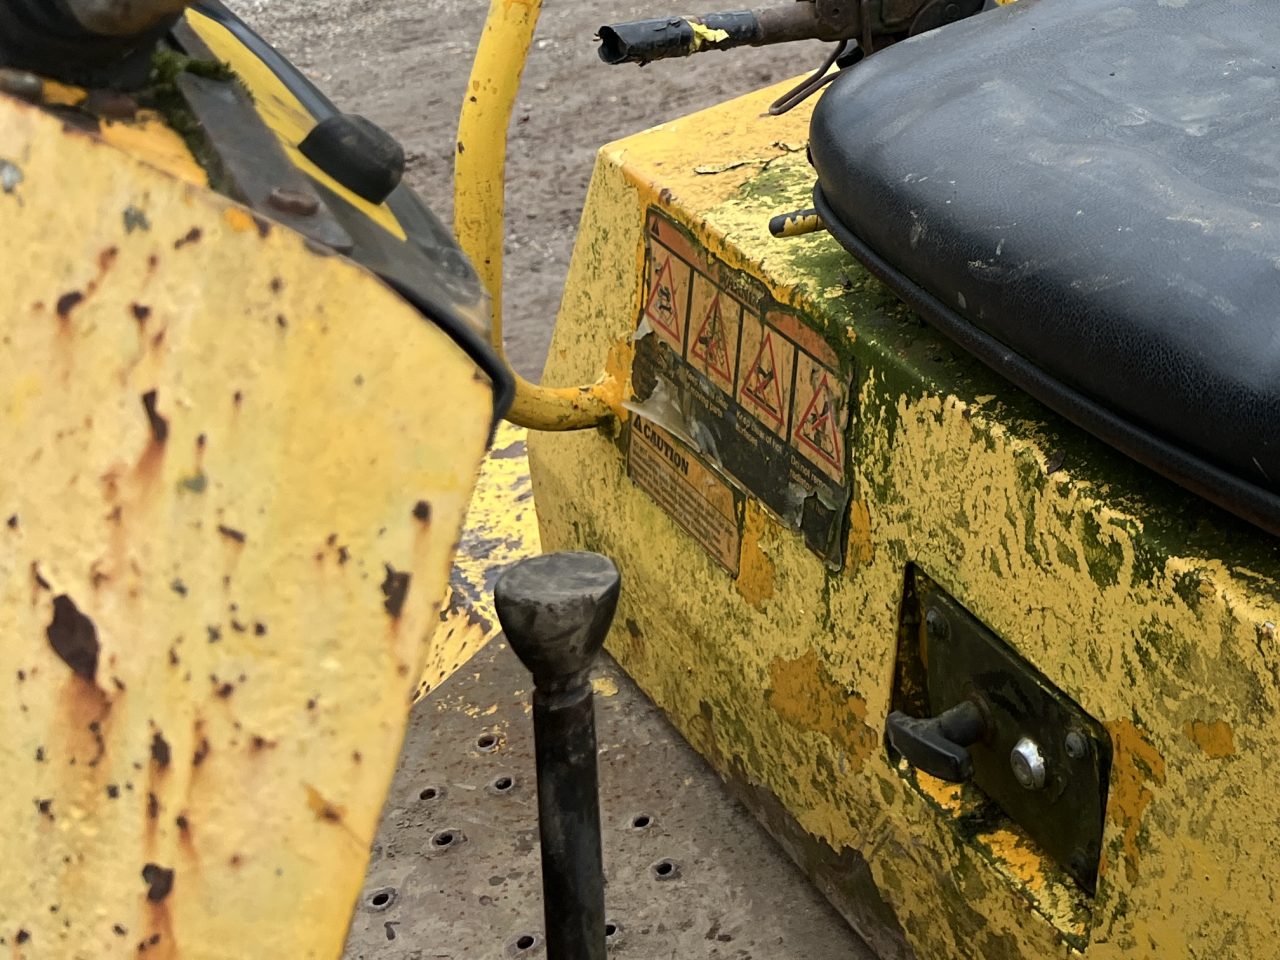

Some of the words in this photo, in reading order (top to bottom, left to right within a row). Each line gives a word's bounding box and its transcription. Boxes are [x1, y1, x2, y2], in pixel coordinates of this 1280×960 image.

[736, 408, 750, 430] Keep
[643, 423, 689, 476] CAUTION
[790, 454, 800, 469] Do
[800, 464, 810, 478] not
